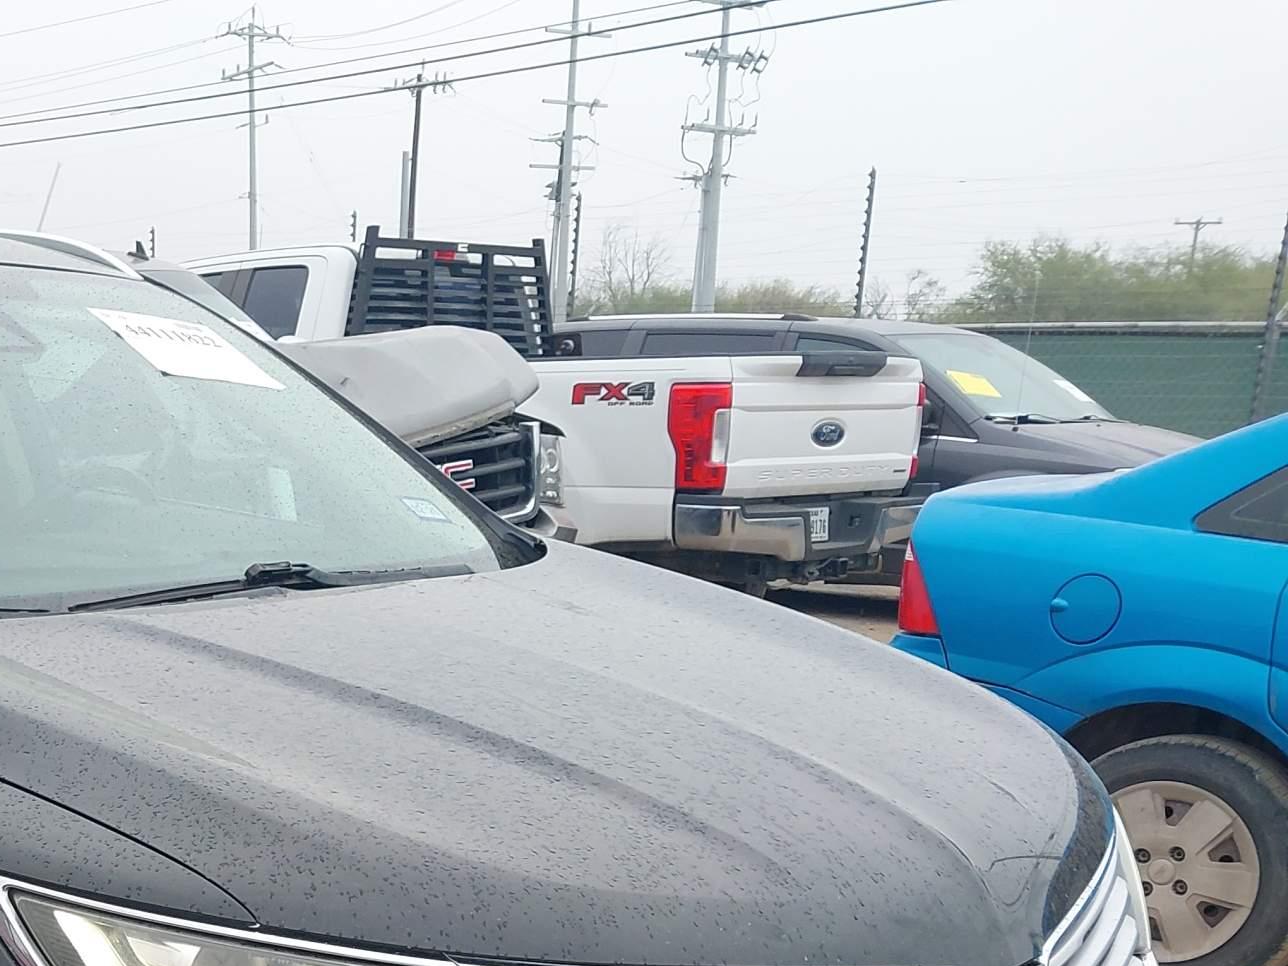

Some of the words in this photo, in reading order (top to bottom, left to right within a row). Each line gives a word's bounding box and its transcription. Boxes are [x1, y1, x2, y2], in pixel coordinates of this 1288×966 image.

[125, 324, 222, 348] 44111822
[572, 382, 655, 405] FX4
[758, 466, 832, 481] SUPER
[839, 464, 890, 478] DUTY
